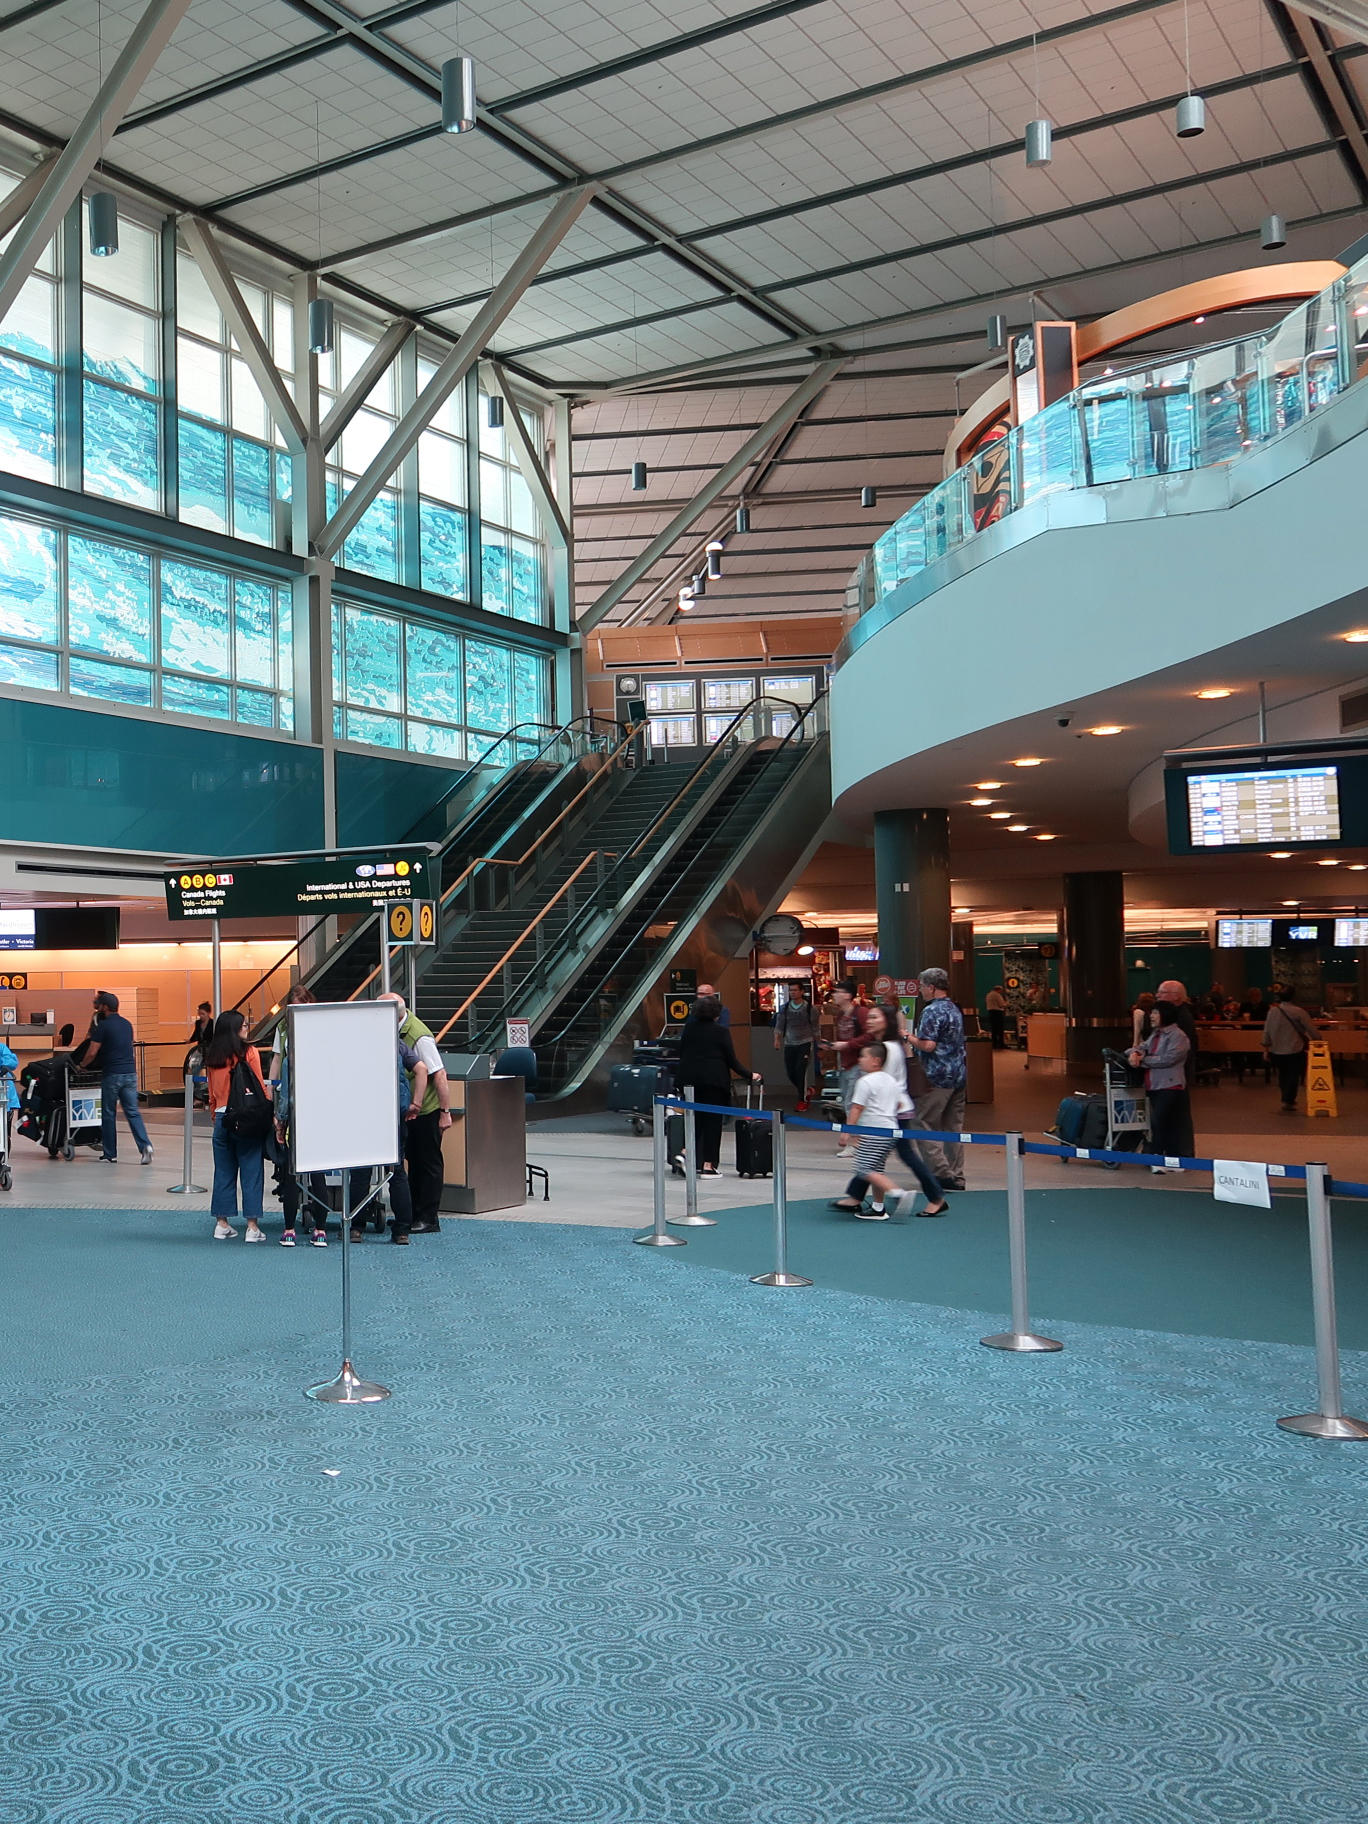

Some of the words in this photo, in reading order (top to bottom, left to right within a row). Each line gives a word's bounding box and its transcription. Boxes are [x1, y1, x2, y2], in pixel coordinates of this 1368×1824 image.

[306, 882, 347, 891] International
[355, 881, 371, 889] USA
[372, 880, 410, 888] Departures
[205, 889, 226, 898] Flights
[297, 893, 323, 902] Départs
[324, 892, 338, 900] vols
[339, 890, 387, 899] internationaux
[397, 888, 411, 896] É-U
[1288, 931, 1317, 939] YVR
[1114, 1109, 1146, 1124] YVR
[1218, 1175, 1260, 1190] CANTALINI
